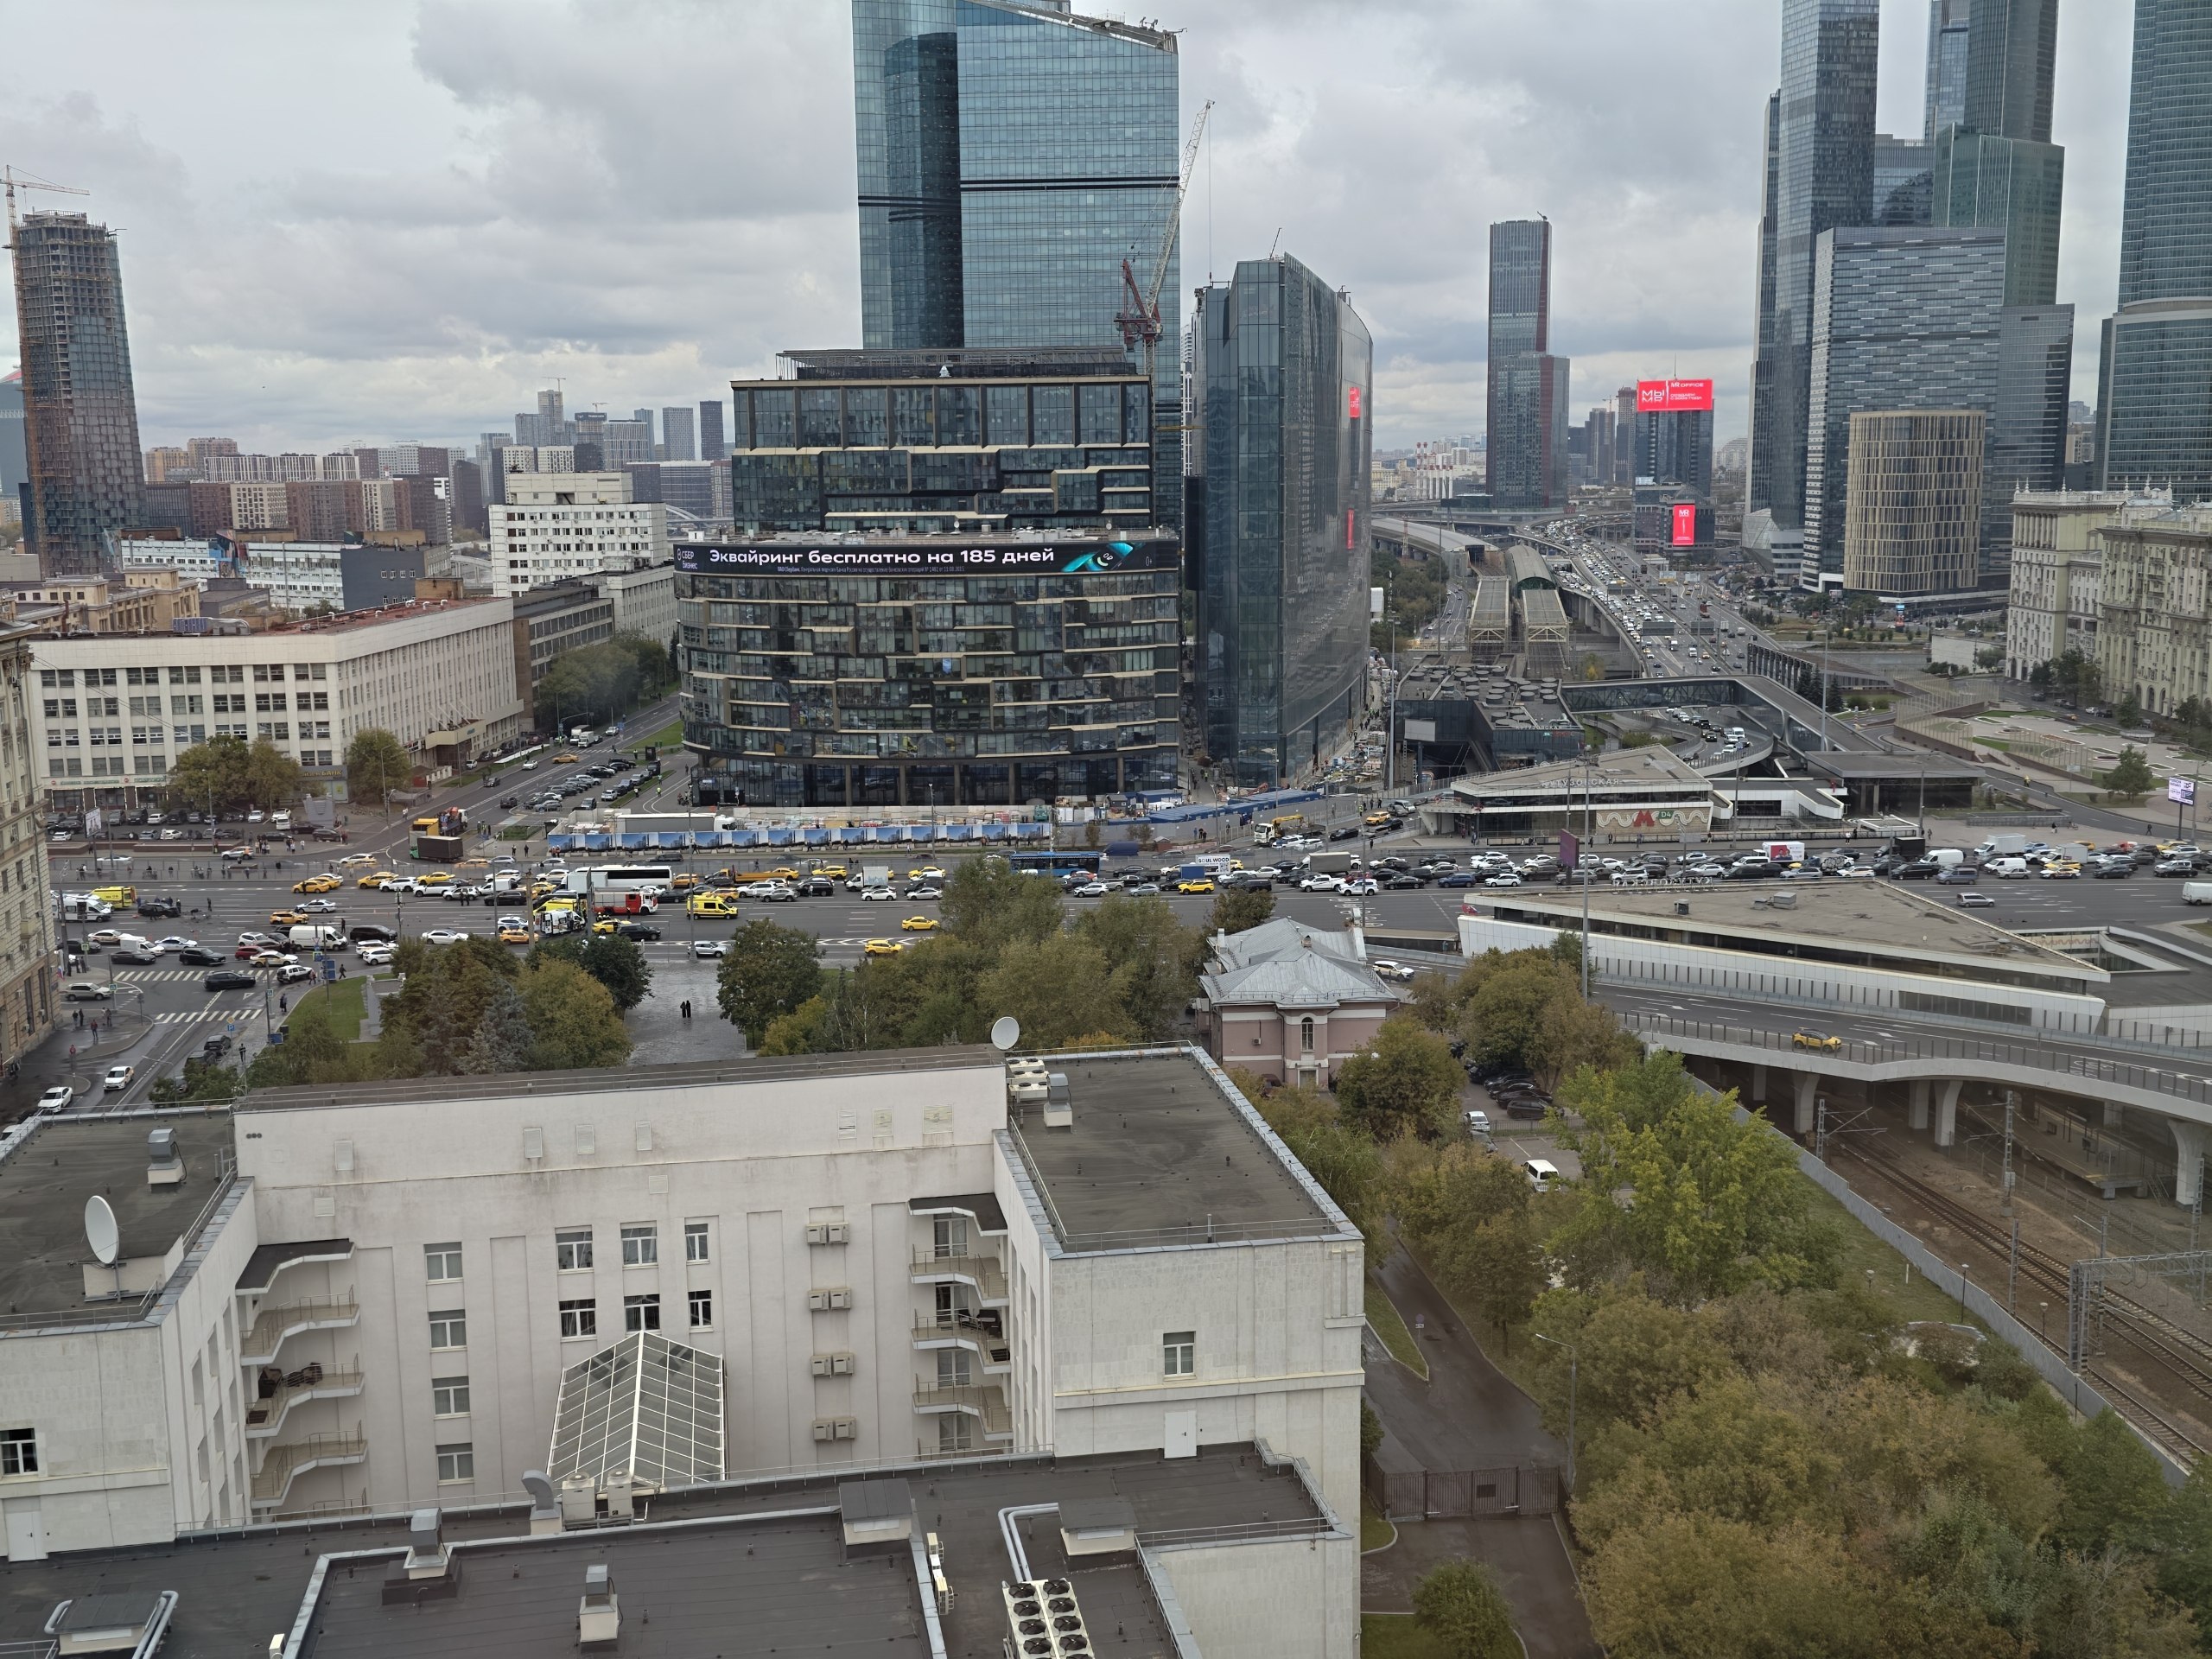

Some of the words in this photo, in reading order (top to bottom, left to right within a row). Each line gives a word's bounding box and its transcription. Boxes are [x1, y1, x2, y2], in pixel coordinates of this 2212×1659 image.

[683, 551, 695, 560] СБЕР
[710, 549, 804, 566] Эквайринг
[809, 550, 921, 563] бесплатно
[928, 553, 954, 563] на
[960, 550, 995, 563] 185
[1002, 548, 1054, 564] дней
[683, 561, 698, 569] Бизнес
